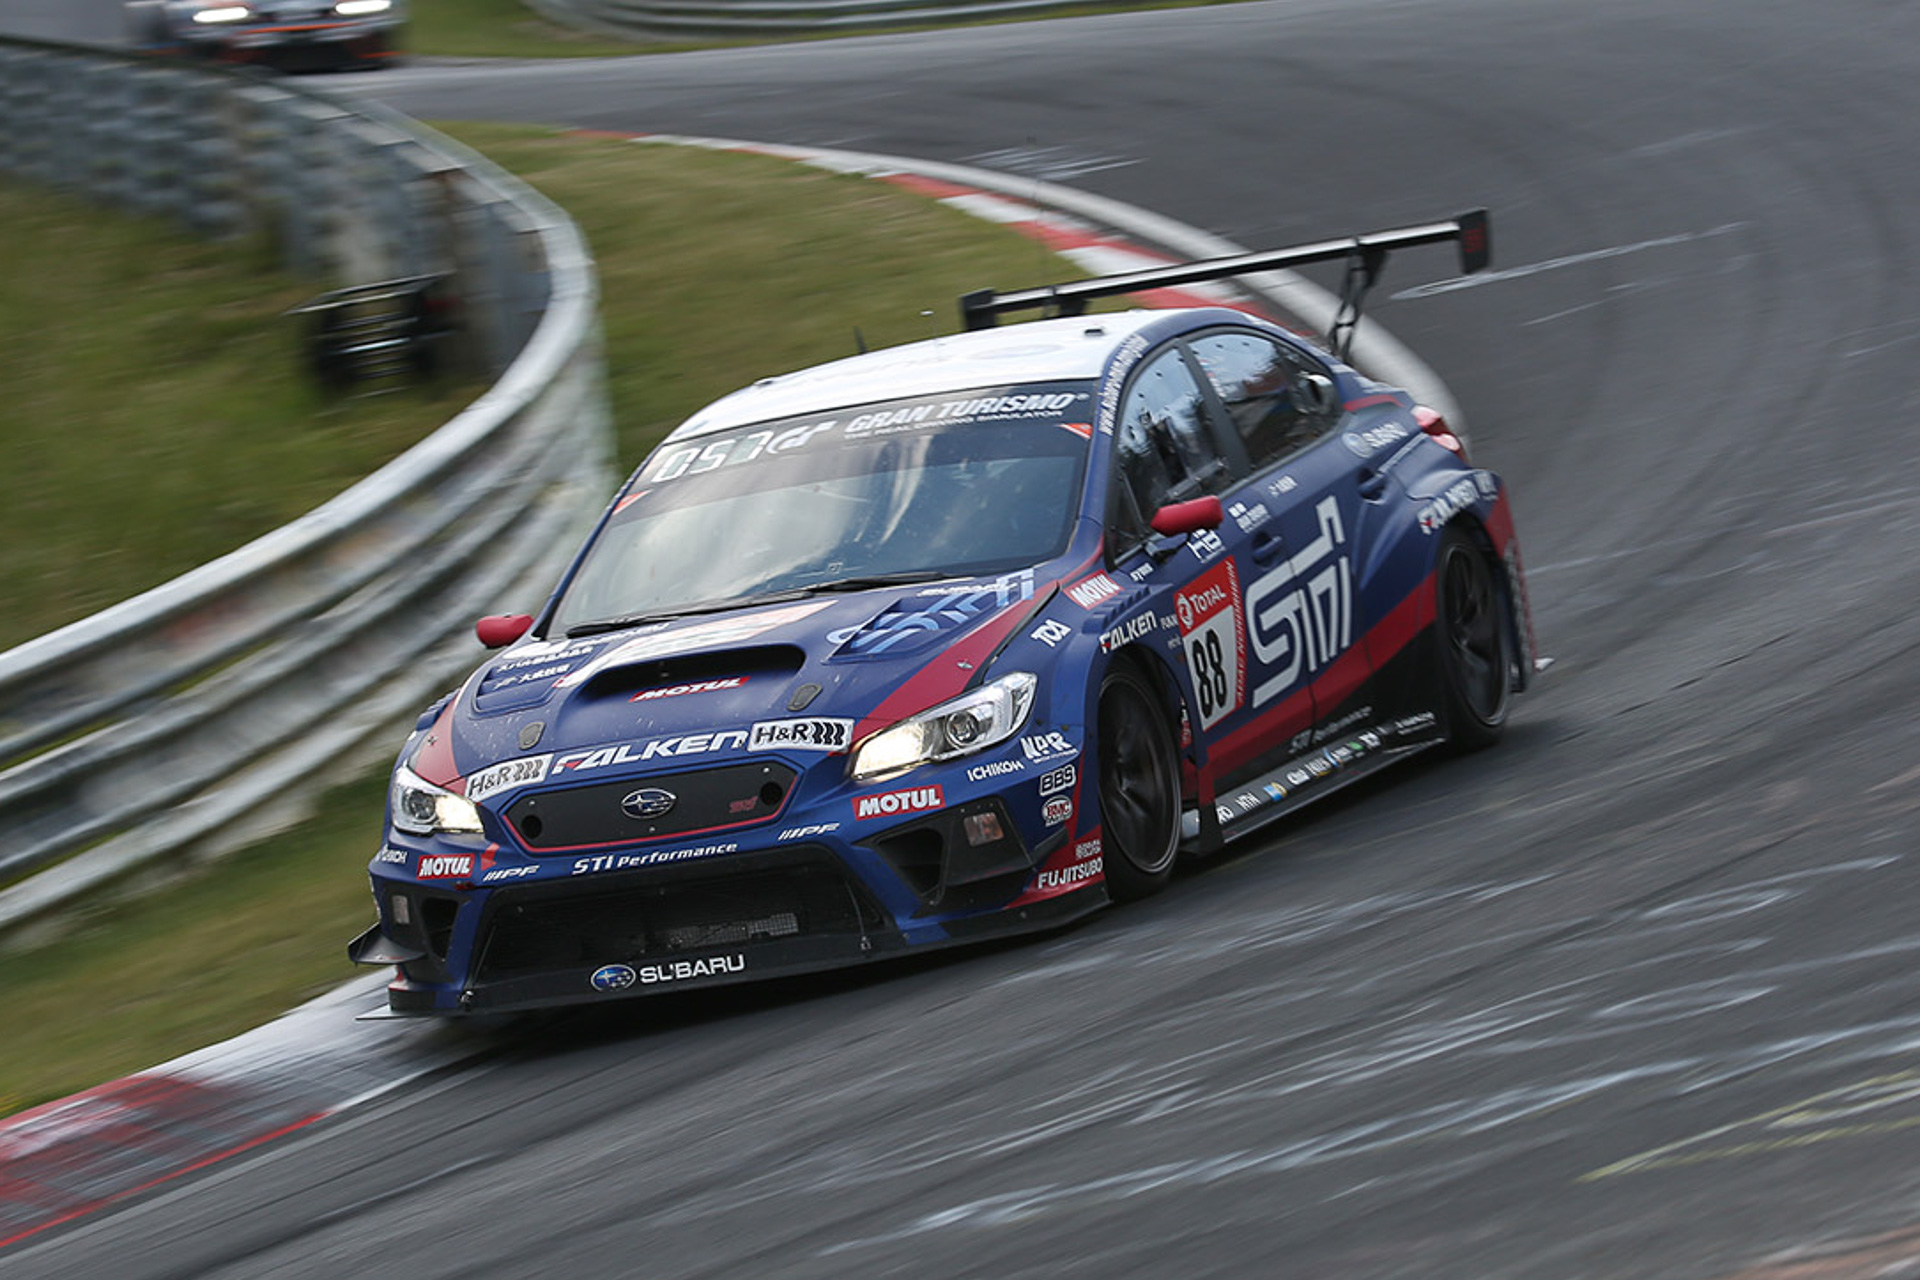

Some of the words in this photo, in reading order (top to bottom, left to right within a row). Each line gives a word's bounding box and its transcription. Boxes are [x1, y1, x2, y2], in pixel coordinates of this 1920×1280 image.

[845, 405, 934, 432] GRAN
[937, 393, 1076, 419] TURISMO
[1068, 573, 1121, 608] MOTUL
[1188, 584, 1227, 614] TOTAL
[1099, 610, 1159, 654] FALKEN
[636, 678, 743, 700] MOTUL
[1192, 628, 1228, 719] 88
[755, 722, 809, 746] H&R
[1020, 731, 1073, 760] NPR
[551, 729, 749, 775] FALKEN
[468, 767, 511, 799] H&R
[1041, 765, 1074, 793] BBS
[858, 787, 942, 818] MOTUL
[418, 856, 471, 878] MOTUL
[571, 854, 615, 876] STI
[617, 842, 738, 868] Performance
[1038, 856, 1103, 889] FUJITSUBO
